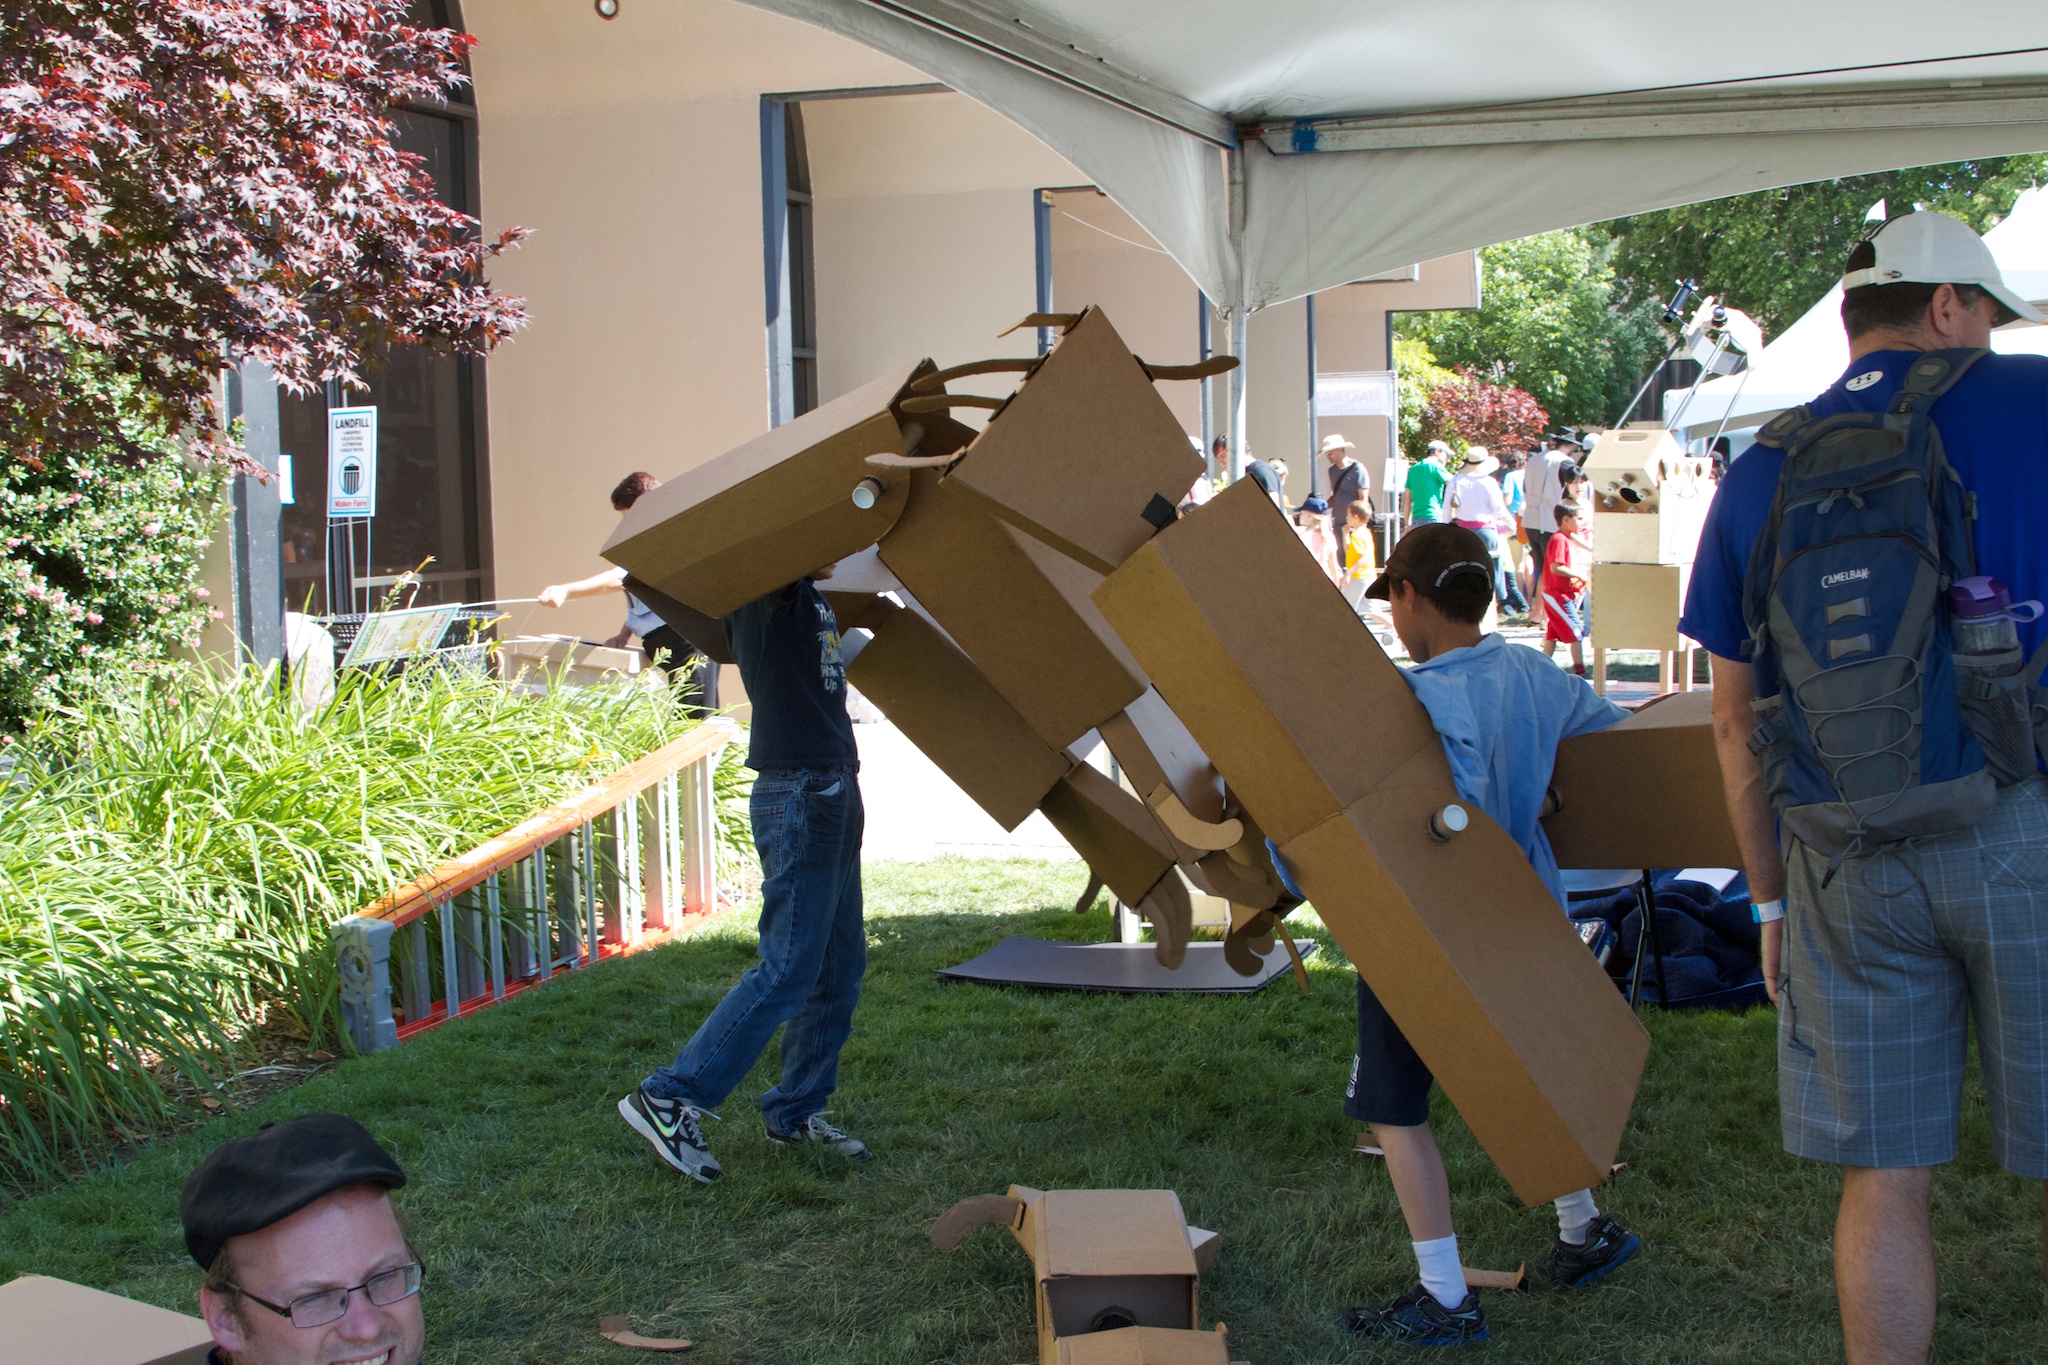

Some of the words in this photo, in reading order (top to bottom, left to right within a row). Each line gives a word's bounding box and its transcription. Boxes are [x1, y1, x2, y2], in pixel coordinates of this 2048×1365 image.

[335, 418, 369, 429] LANDFILL
[334, 500, 352, 508] Maker
[353, 499, 367, 507] Faire
[1821, 567, 1869, 588] CAMELBAK
[824, 678, 838, 694] Up
